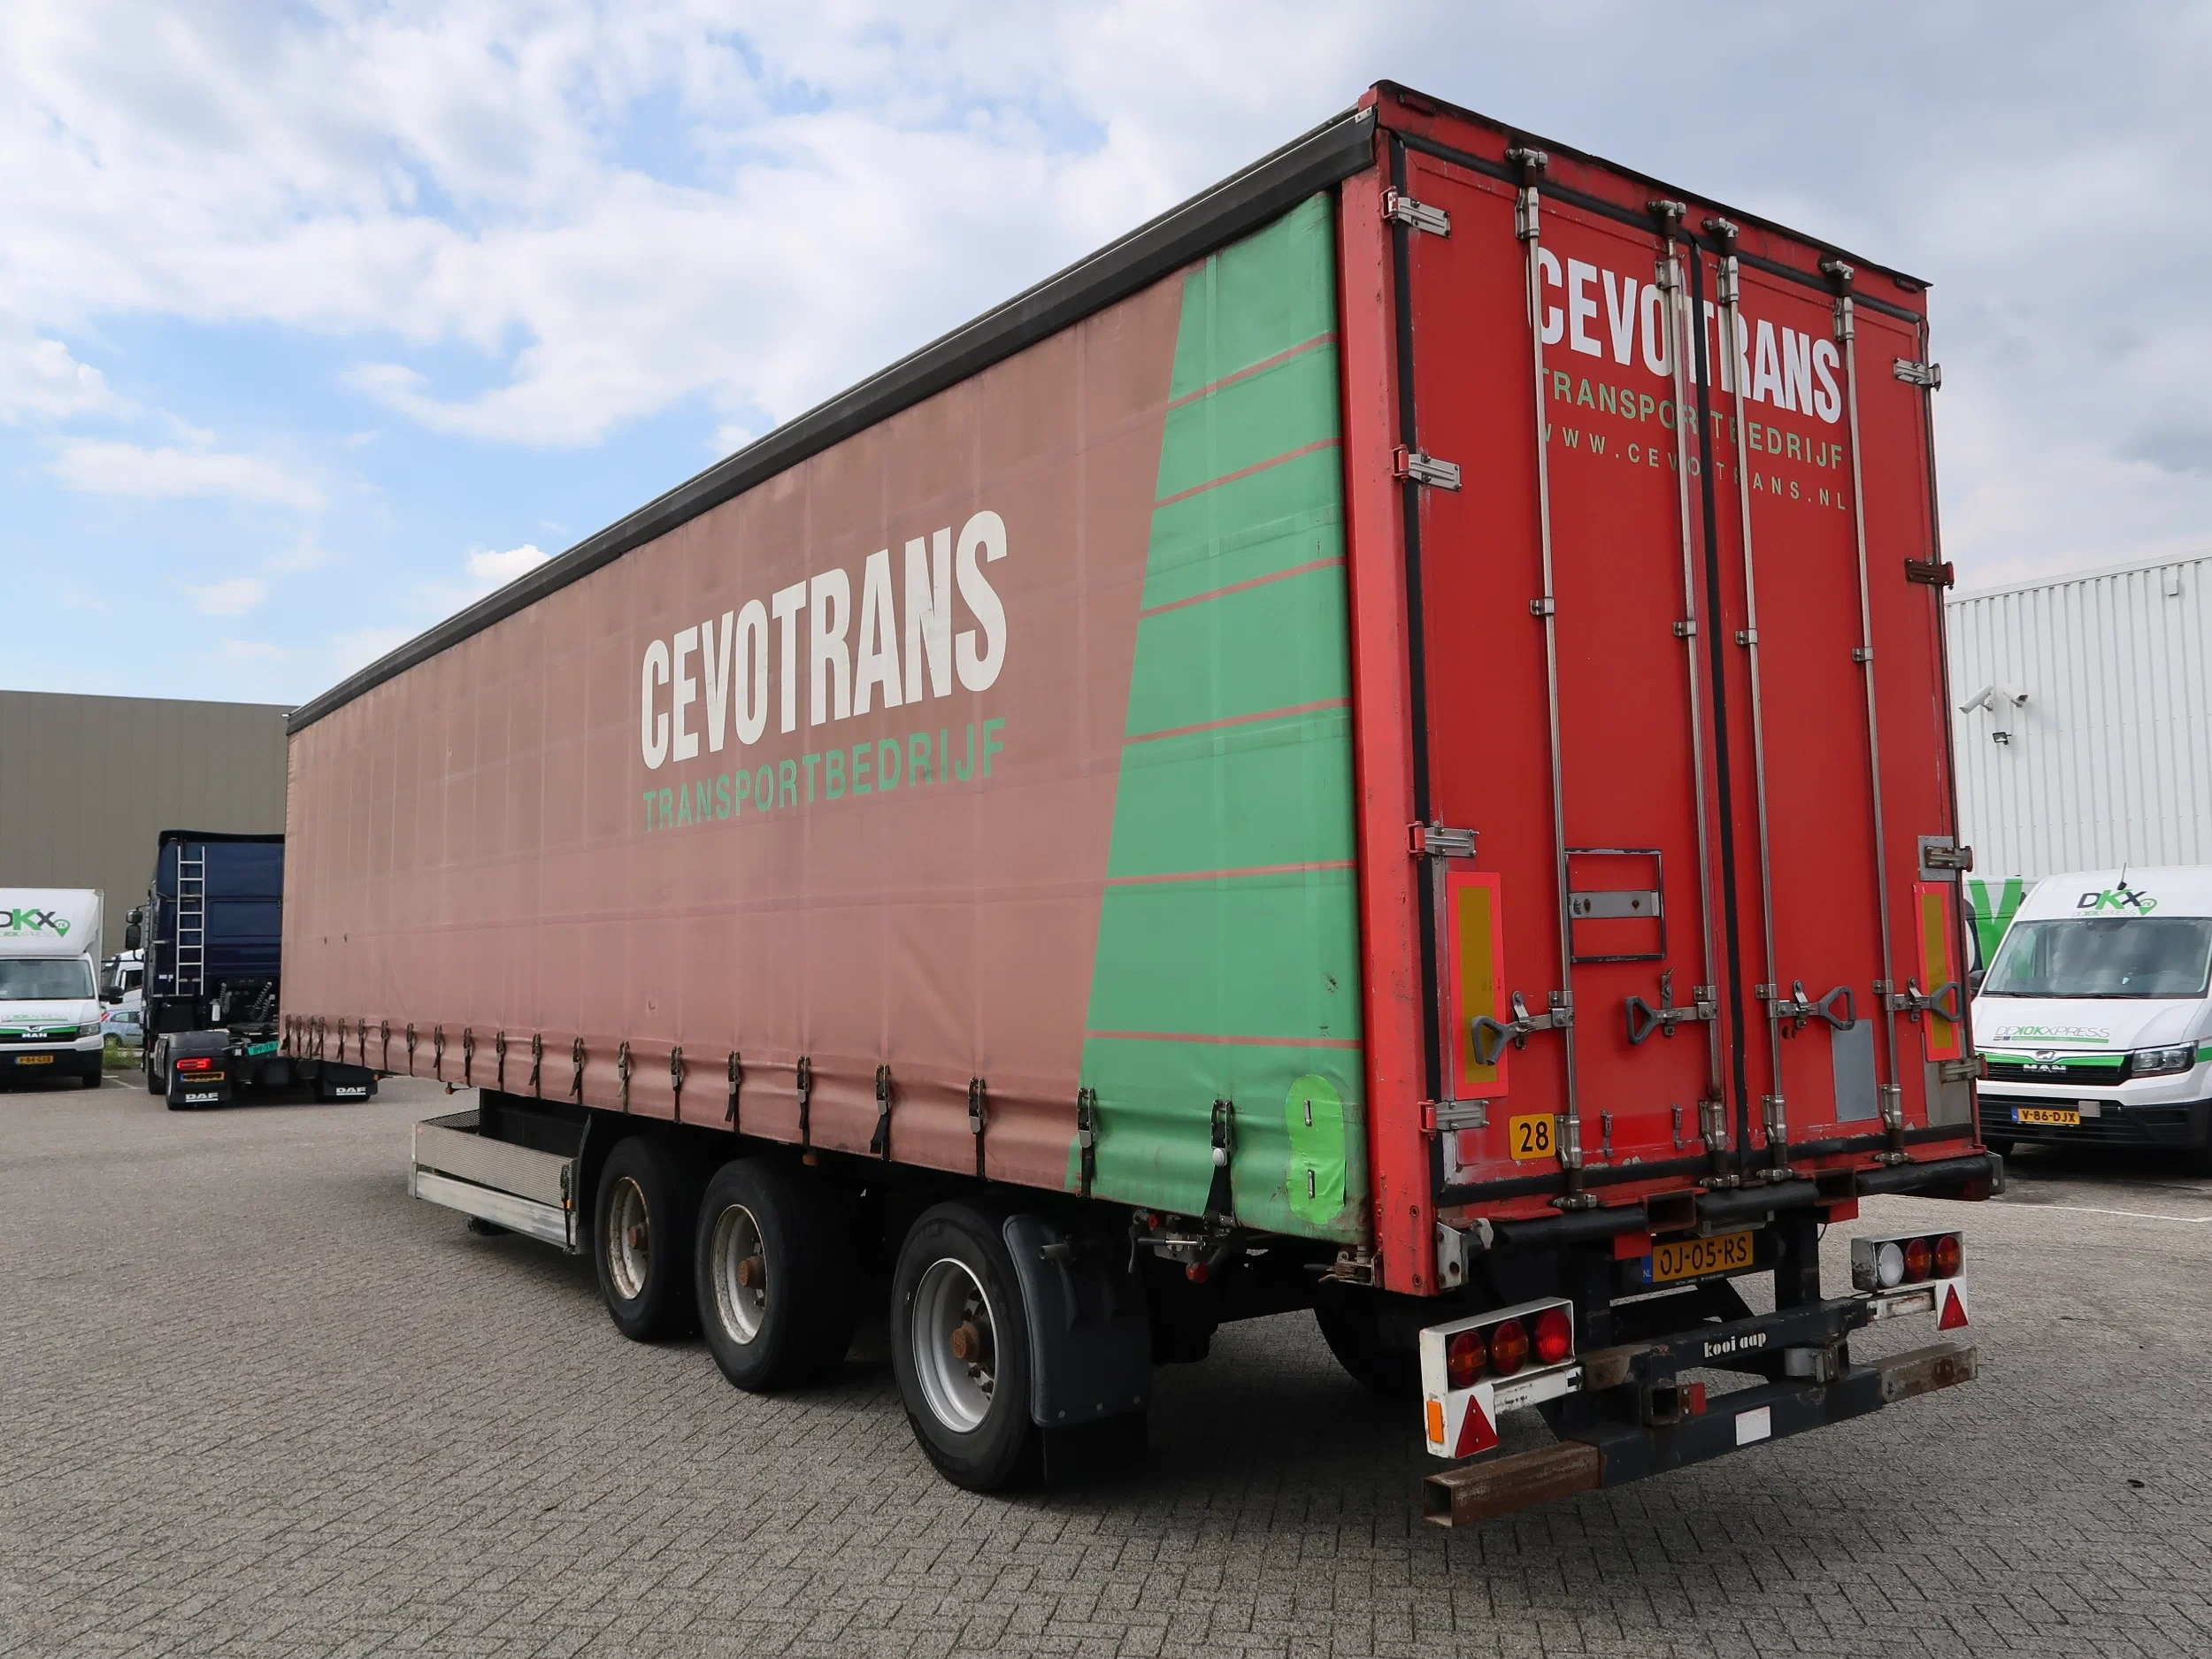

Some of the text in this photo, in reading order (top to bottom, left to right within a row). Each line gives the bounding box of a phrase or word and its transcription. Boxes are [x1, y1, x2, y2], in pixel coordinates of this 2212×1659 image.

[1525, 246, 1841, 424] CEVOTRANS
[641, 510, 1007, 770] CEVOTRANS
[643, 717, 1005, 832] TRANSPORTBEDRIJF
[2076, 888, 2147, 910] DKX
[1994, 1026, 2110, 1037] DEKOKXPRESS
[2023, 1064, 2067, 1073] MAN
[2022, 1110, 2076, 1122] V-86-DJX
[1519, 1120, 1548, 1152] 28
[1660, 1236, 1747, 1276] OJ-05-RS
[1704, 1333, 1766, 1358] kooi aap
